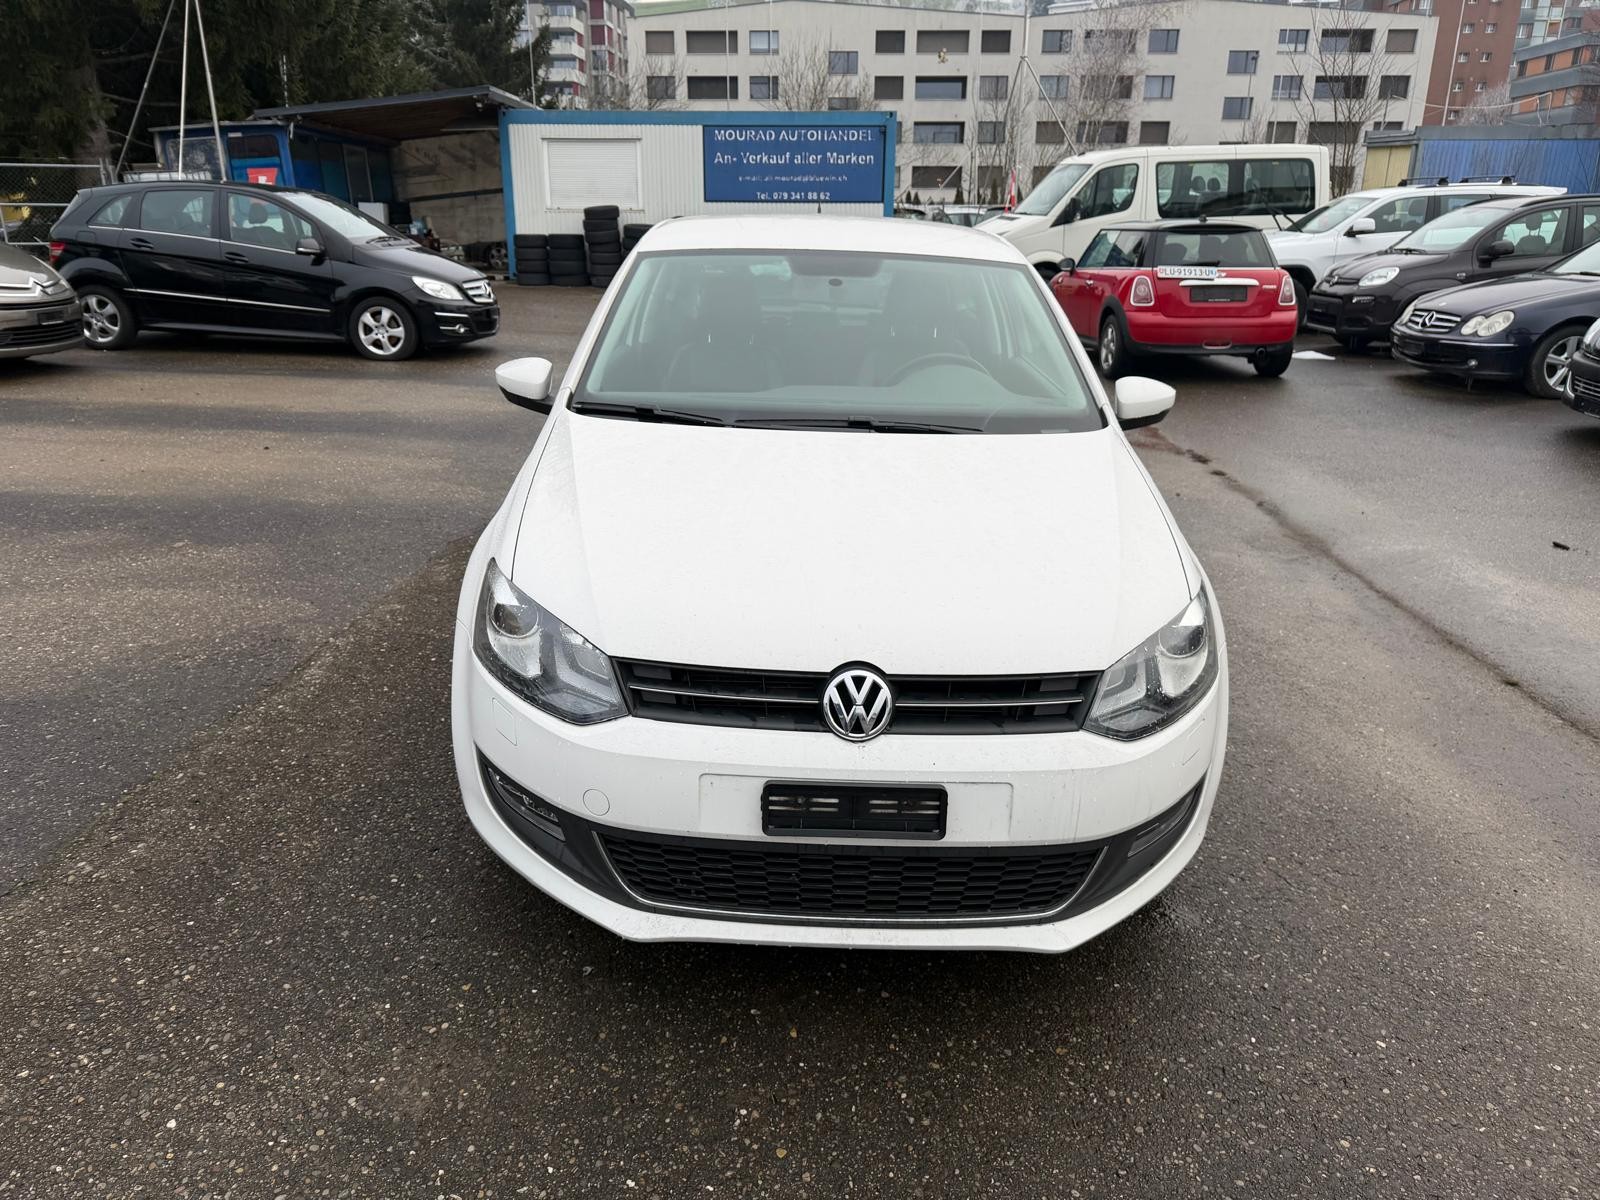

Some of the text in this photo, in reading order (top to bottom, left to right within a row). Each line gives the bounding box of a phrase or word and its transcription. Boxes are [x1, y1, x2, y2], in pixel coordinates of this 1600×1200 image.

[714, 129, 875, 142] MOURAD AUTOHANDEL
[714, 151, 875, 164] An- Verkauf aller Marken
[756, 191, 771, 200] Tel.
[772, 191, 788, 200] 079
[790, 191, 805, 200] 341
